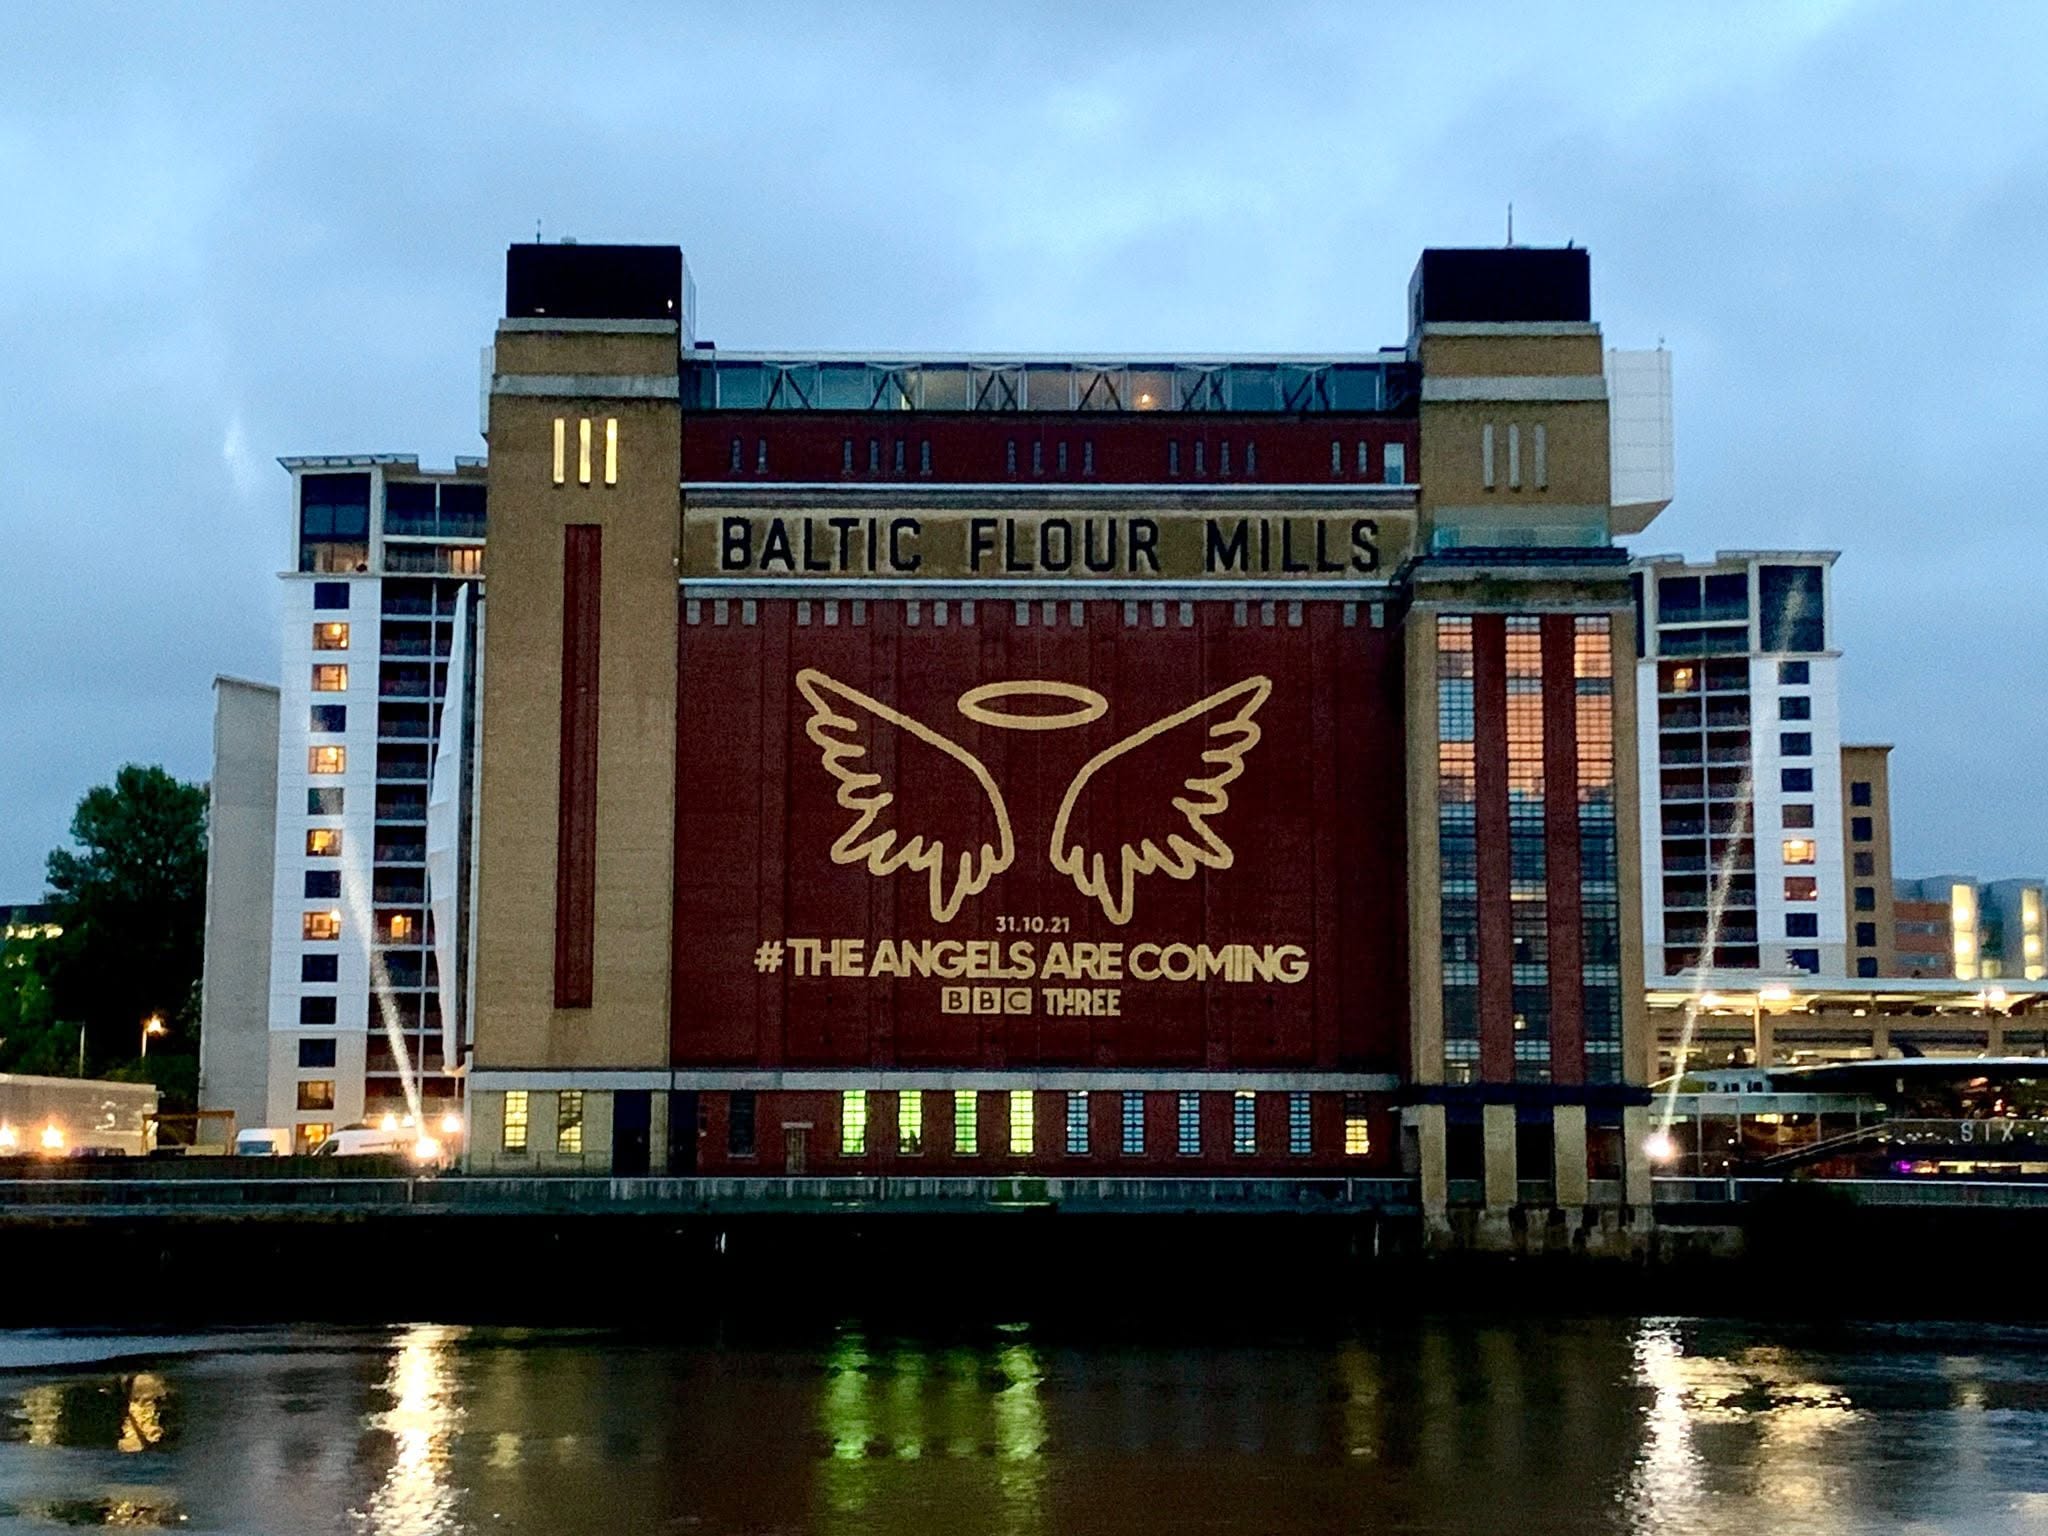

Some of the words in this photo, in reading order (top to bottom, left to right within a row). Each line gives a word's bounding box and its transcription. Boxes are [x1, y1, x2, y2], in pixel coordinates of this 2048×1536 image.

[722, 517, 922, 573] BALTIC
[970, 518, 1161, 573] FLOUR
[1205, 517, 1380, 574] MILLS
[996, 916, 1070, 933] 31.10.21
[941, 987, 1033, 1015] BBC
[1042, 988, 1121, 1016] THREE
